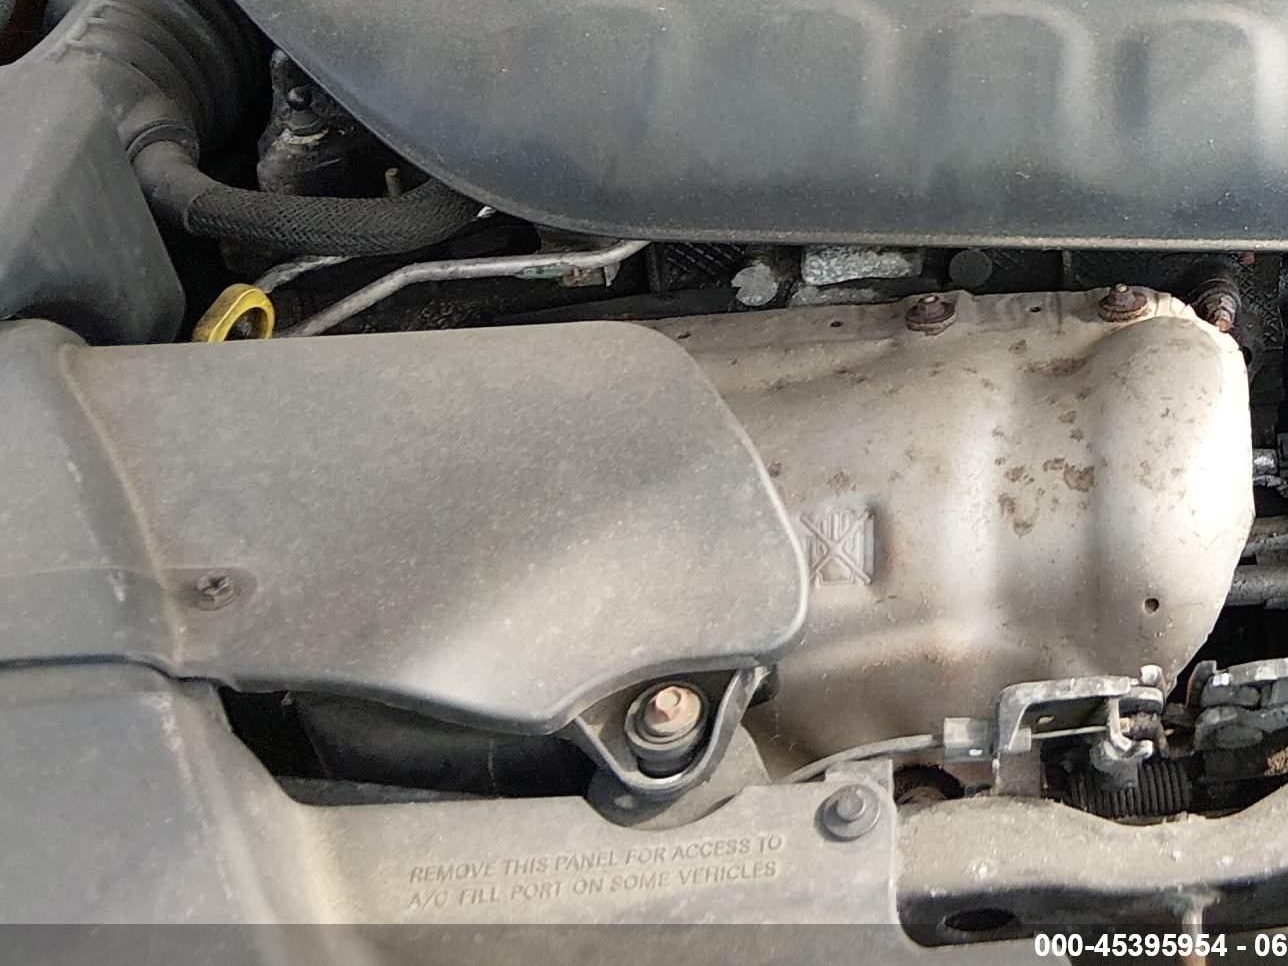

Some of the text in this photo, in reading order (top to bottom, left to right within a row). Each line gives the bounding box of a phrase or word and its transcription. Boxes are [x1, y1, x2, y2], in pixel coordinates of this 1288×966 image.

[408, 835, 783, 884] REMOVE THIS PANEL FOR ACCESS TO
[407, 860, 778, 909] A/C FILL PORT ON SOME VEHICLES
